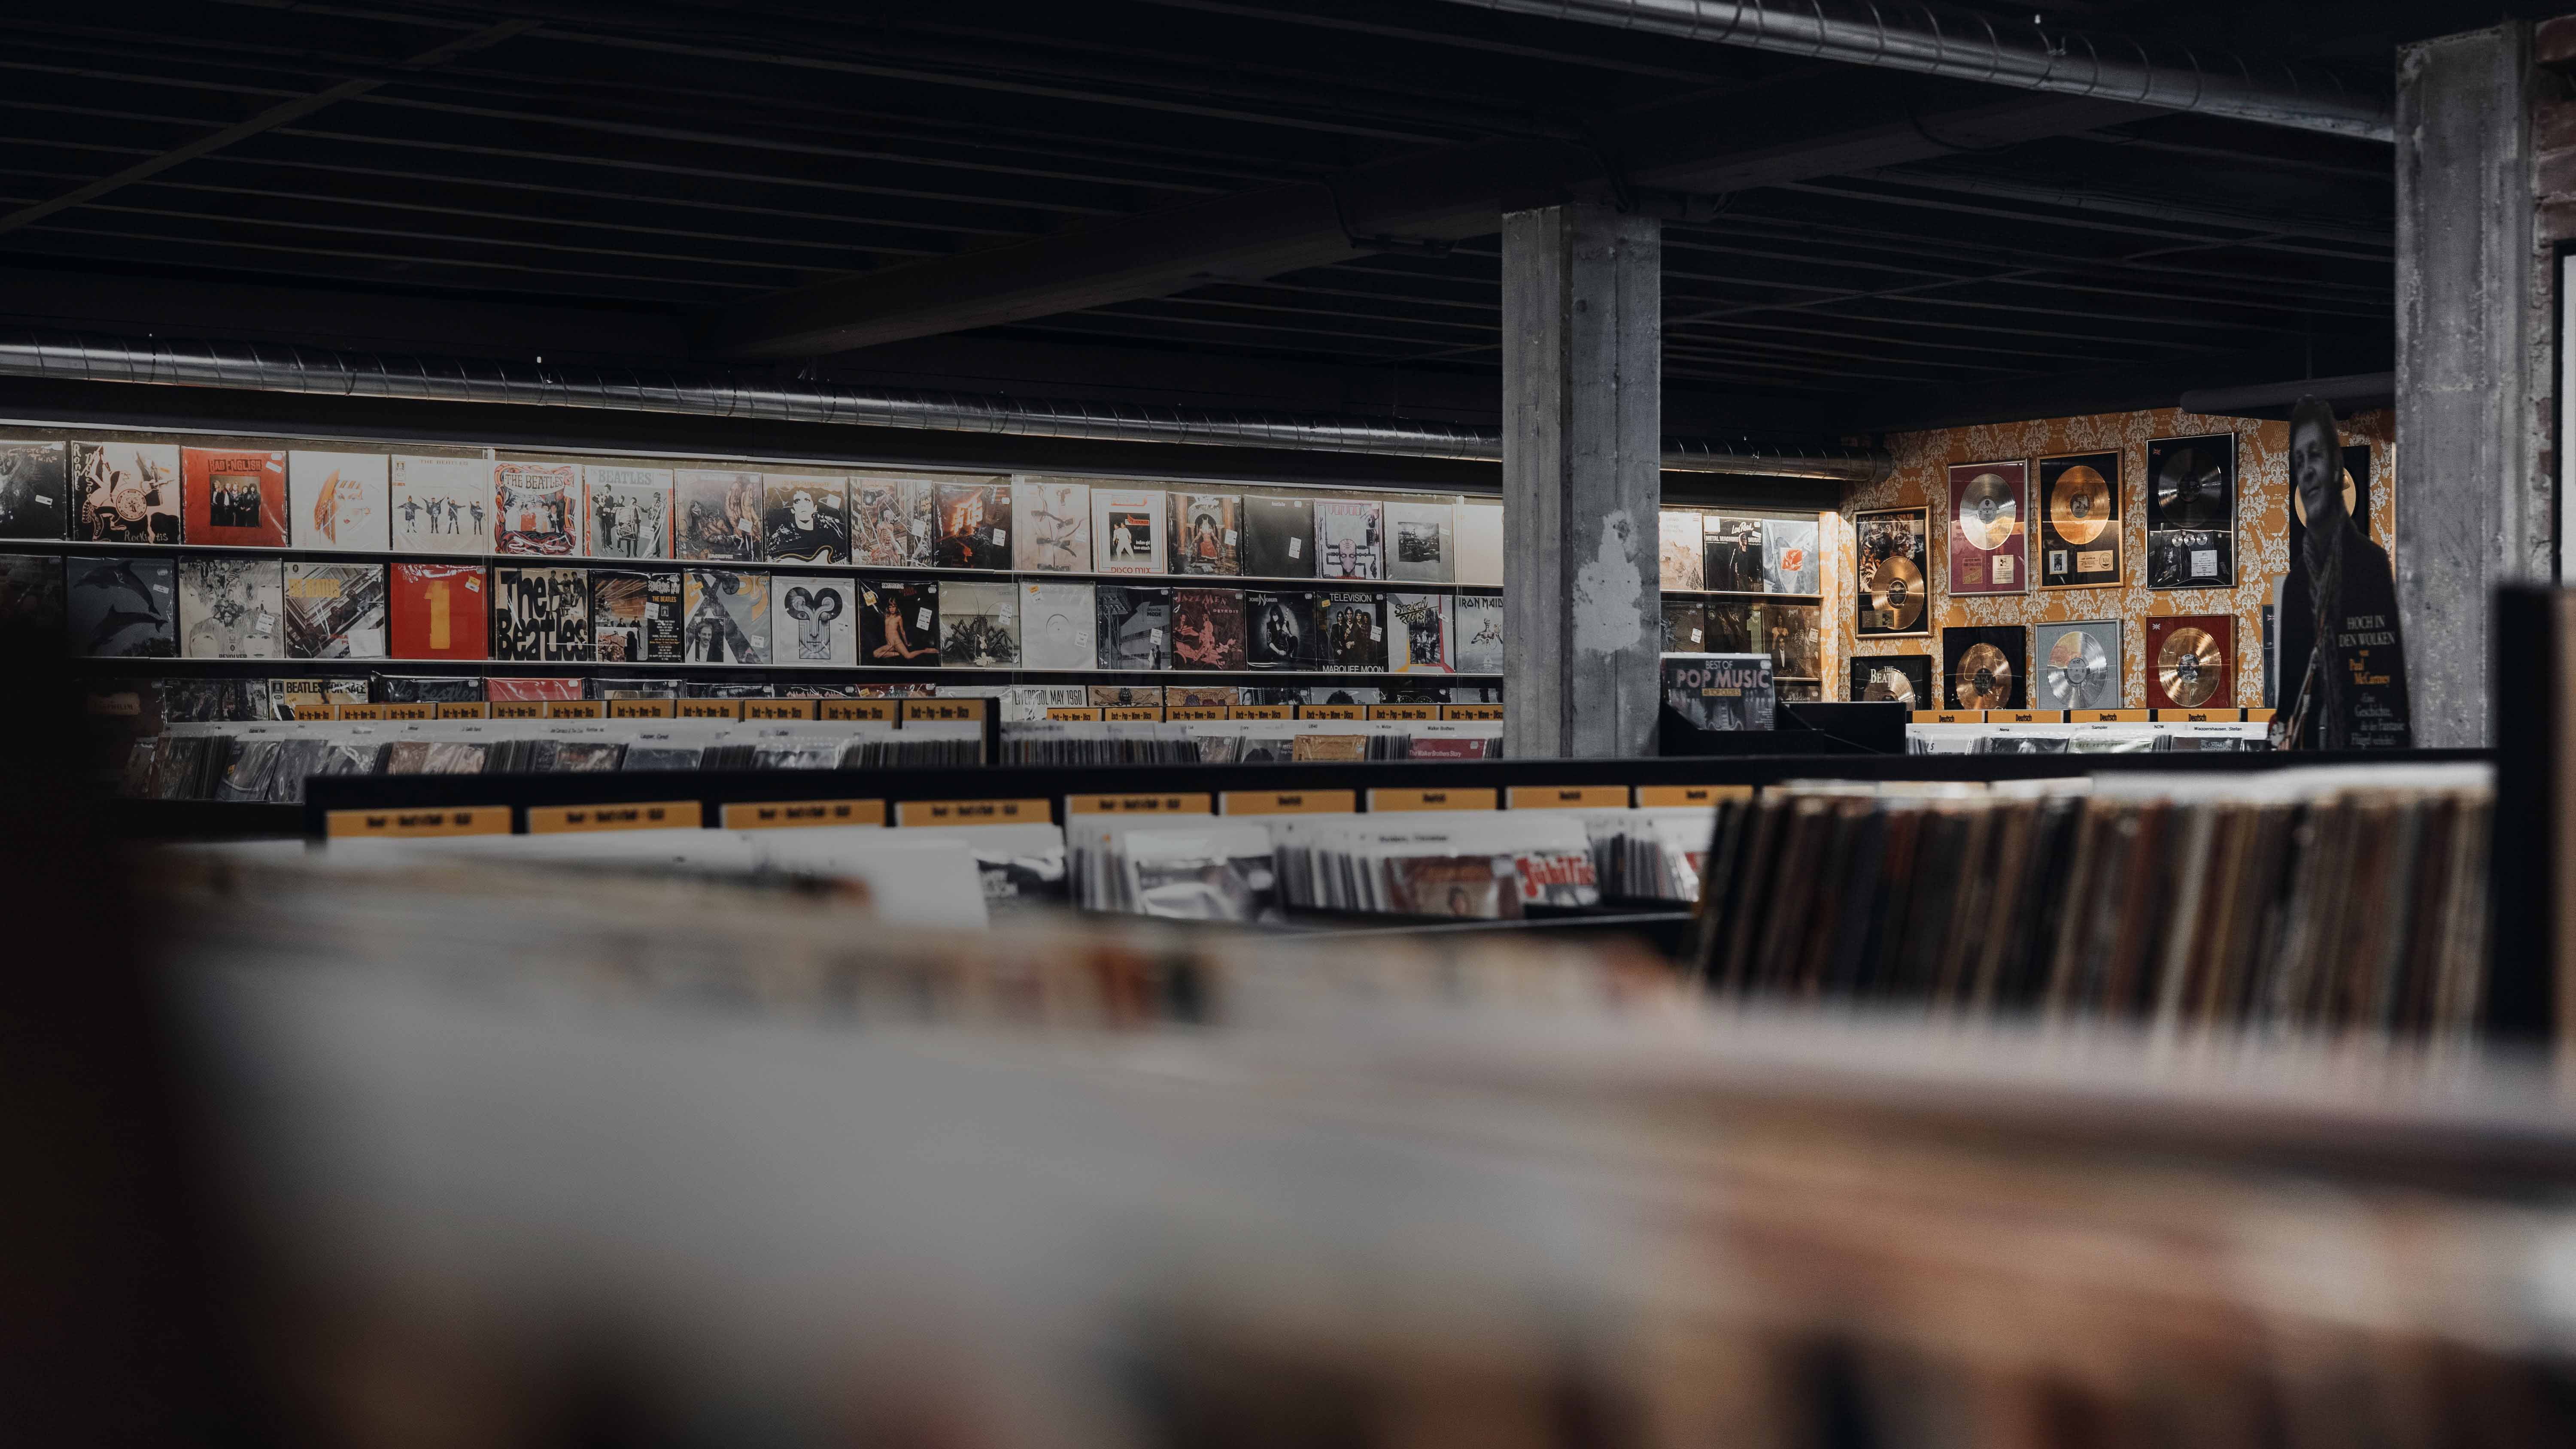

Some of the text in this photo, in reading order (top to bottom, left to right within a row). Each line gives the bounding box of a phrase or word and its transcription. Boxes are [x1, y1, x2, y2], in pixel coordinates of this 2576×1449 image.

[209, 459, 262, 472] BAD ENGLISH
[505, 474, 564, 489] THE BEATLES
[598, 469, 652, 485] BEATLES
[124, 530, 169, 543] Rockitis
[500, 568, 547, 619] The
[1329, 593, 1372, 603] TELEVISION
[1394, 596, 1428, 614] STRICTLY
[1459, 597, 1504, 611] IRON MAID
[424, 580, 450, 649] 1
[2346, 615, 2386, 630] HOCH IN
[497, 606, 588, 661] Beatles
[2339, 632, 2396, 647] DEN WOLKEN
[1705, 660, 1733, 670] BEST OF
[2349, 658, 2364, 671] Paul
[1676, 669, 1771, 688] POP MUSIC
[1870, 669, 1906, 687] BEATES
[286, 682, 324, 694] BEATLES
[1050, 689, 1064, 705] MAY
[1066, 689, 1082, 705] 1960
[1194, 711, 1203, 719] Wave
[1206, 711, 1215, 719] Disco
[1236, 710, 1244, 718] Rock
[1258, 710, 1268, 718] Wave
[1271, 710, 1281, 718] Disco
[1306, 710, 1315, 718] Rock
[1330, 710, 1340, 718] Wave
[1344, 710, 1354, 718] Disco
[1376, 710, 1385, 718] Rock
[1402, 710, 1413, 718] Wave
[1416, 710, 1426, 718] Disco
[1939, 715, 1955, 723] Deutsch
[2015, 714, 2032, 722] Deutsch
[2188, 713, 2207, 721] Deutsch
